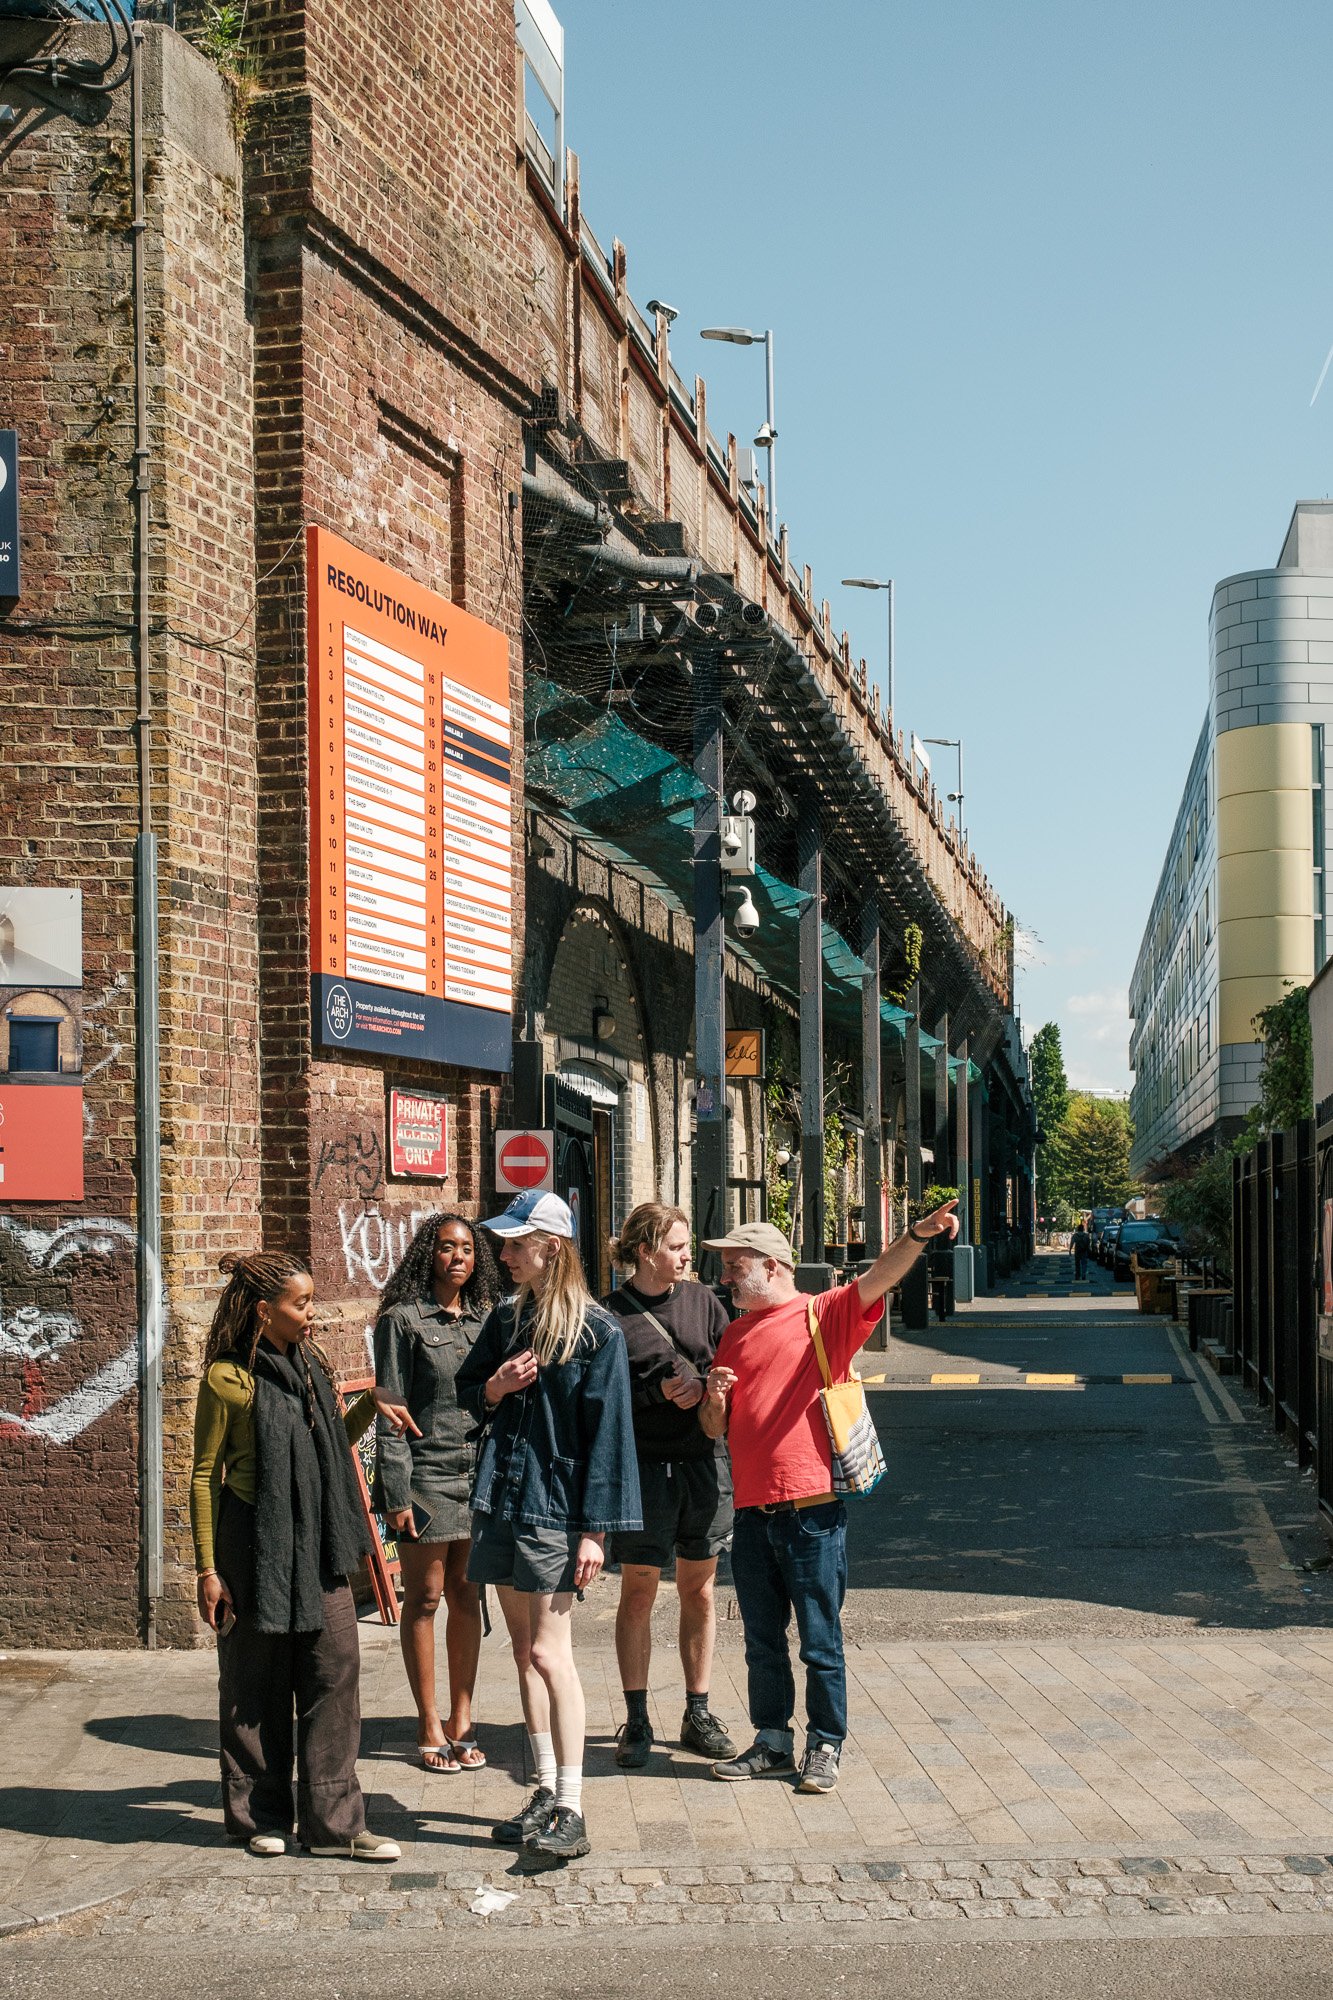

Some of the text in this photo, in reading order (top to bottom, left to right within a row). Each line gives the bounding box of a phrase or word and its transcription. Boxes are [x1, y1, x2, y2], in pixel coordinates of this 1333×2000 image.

[328, 564, 447, 646] RESOLUTION WAY
[329, 623, 332, 632] 1
[329, 646, 333, 656] 2
[329, 670, 333, 680] 3
[429, 674, 434, 684] 16
[329, 694, 333, 704] 4
[429, 696, 434, 705] 17
[330, 718, 333, 728] 5
[429, 717, 435, 728] 18
[429, 739, 435, 749] 19
[330, 742, 334, 752] 6
[348, 750, 369, 764] OVERDRIVE
[429, 761, 436, 771] 20
[330, 766, 334, 776] 7
[348, 774, 369, 788] OVERDRIVE
[429, 783, 435, 793] 21
[330, 790, 334, 800] 8
[356, 800, 366, 808] SHOP
[429, 805, 436, 815] 22
[330, 814, 335, 824] 9
[429, 827, 436, 837] 23
[329, 838, 336, 848] 10
[429, 848, 436, 858] 24
[330, 862, 336, 872] 11
[430, 871, 436, 880] 25
[330, 886, 336, 896] 12
[361, 896, 377, 905] LONDON
[330, 910, 336, 920] 13
[361, 919, 377, 928] LONDON
[431, 915, 436, 924] A
[330, 934, 336, 944] 14
[358, 941, 380, 952] COMMANDO
[381, 947, 395, 956] TEMPLE
[432, 937, 435, 946] B
[330, 957, 336, 968] 15
[358, 965, 380, 975] COMMANDO
[381, 970, 395, 978] TEMPLE
[432, 959, 435, 968] C
[432, 981, 436, 990] D
[333, 994, 346, 1007] THE
[331, 1006, 348, 1018] ARCH
[356, 1001, 373, 1012] Property
[374, 1006, 390, 1014] available
[391, 1008, 412, 1018] throughout
[335, 1018, 345, 1029] CO
[396, 1098, 442, 1121] PRIVATE
[406, 1148, 434, 1165] ONLY
